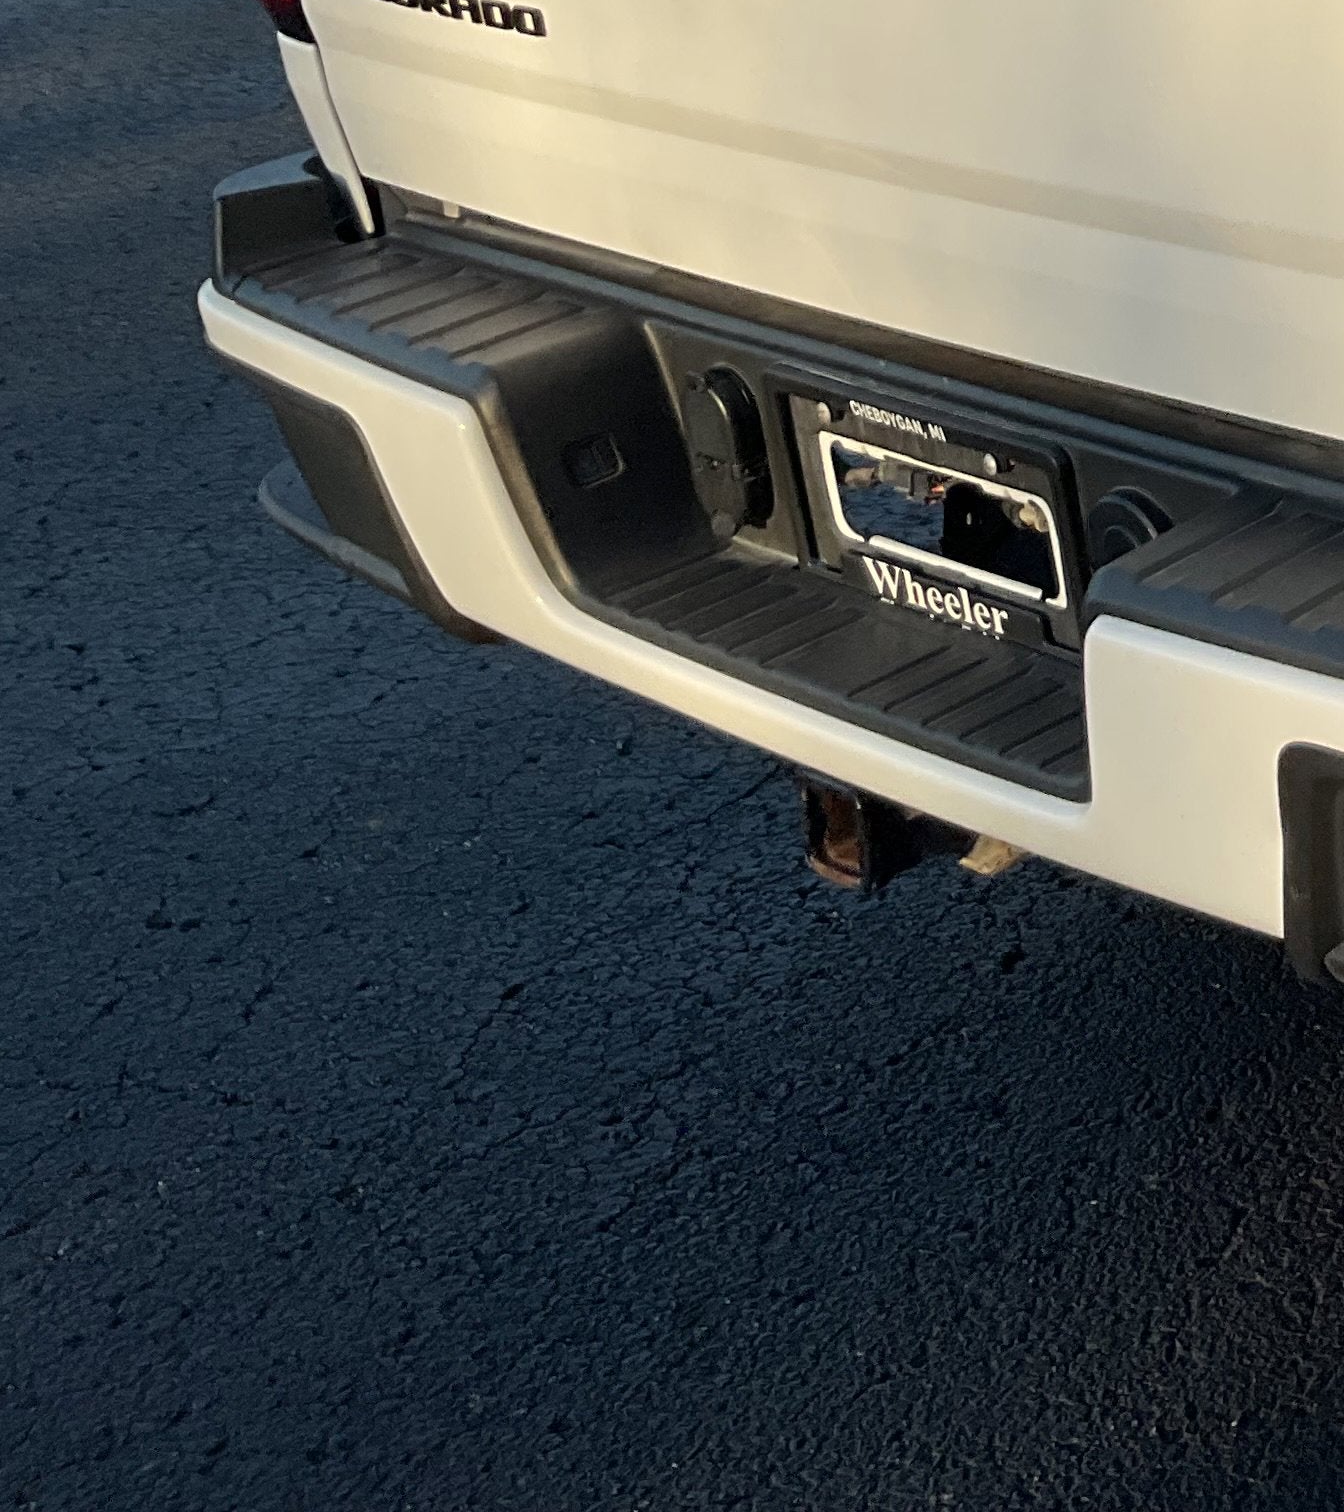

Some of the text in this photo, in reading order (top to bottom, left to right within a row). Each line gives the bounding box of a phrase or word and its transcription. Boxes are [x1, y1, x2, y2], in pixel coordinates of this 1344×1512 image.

[849, 400, 946, 443] CHEBOYGAN, MI
[862, 555, 1009, 635] Wheeler
